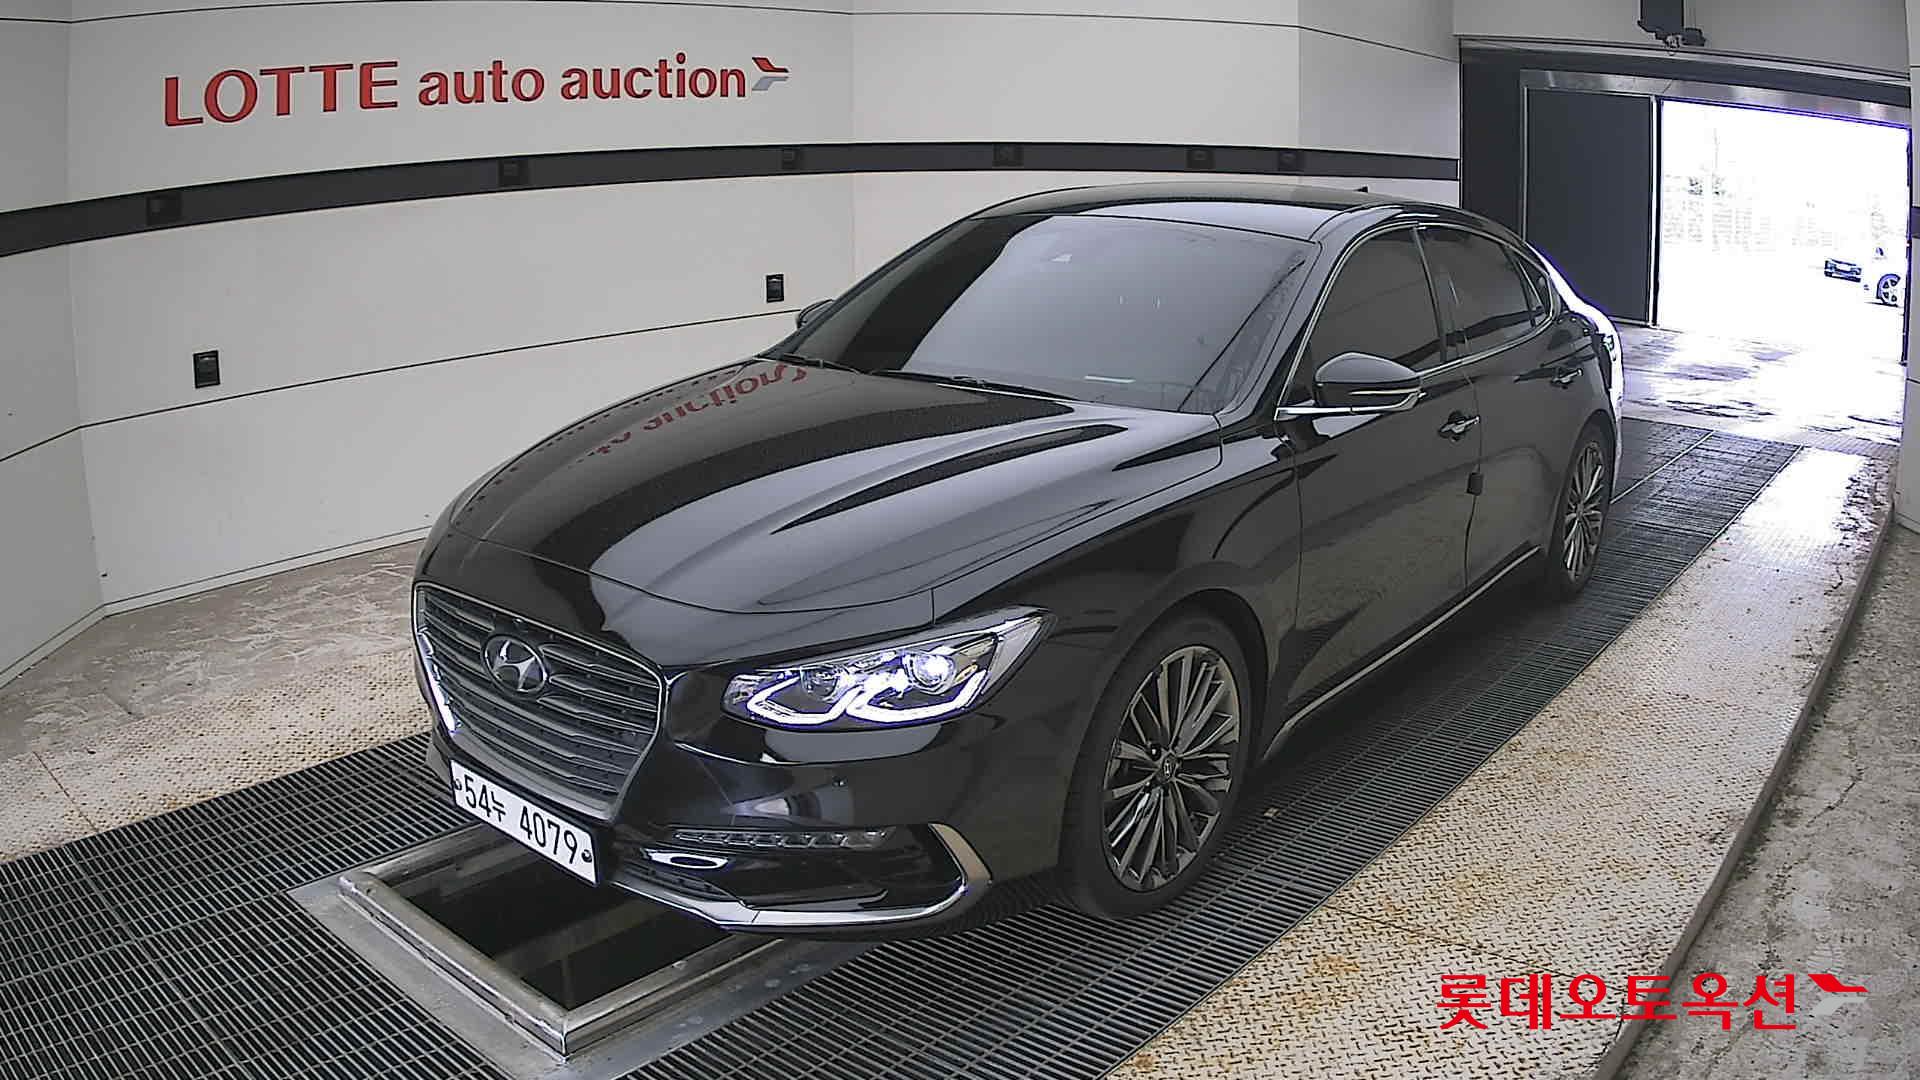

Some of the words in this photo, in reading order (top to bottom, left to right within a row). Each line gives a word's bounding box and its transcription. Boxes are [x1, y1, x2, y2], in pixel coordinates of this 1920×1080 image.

[164, 61, 399, 128] LOTTE
[418, 60, 545, 106] auto
[560, 53, 747, 101] auction
[463, 774, 506, 823] 54누
[519, 806, 578, 864] 4079
